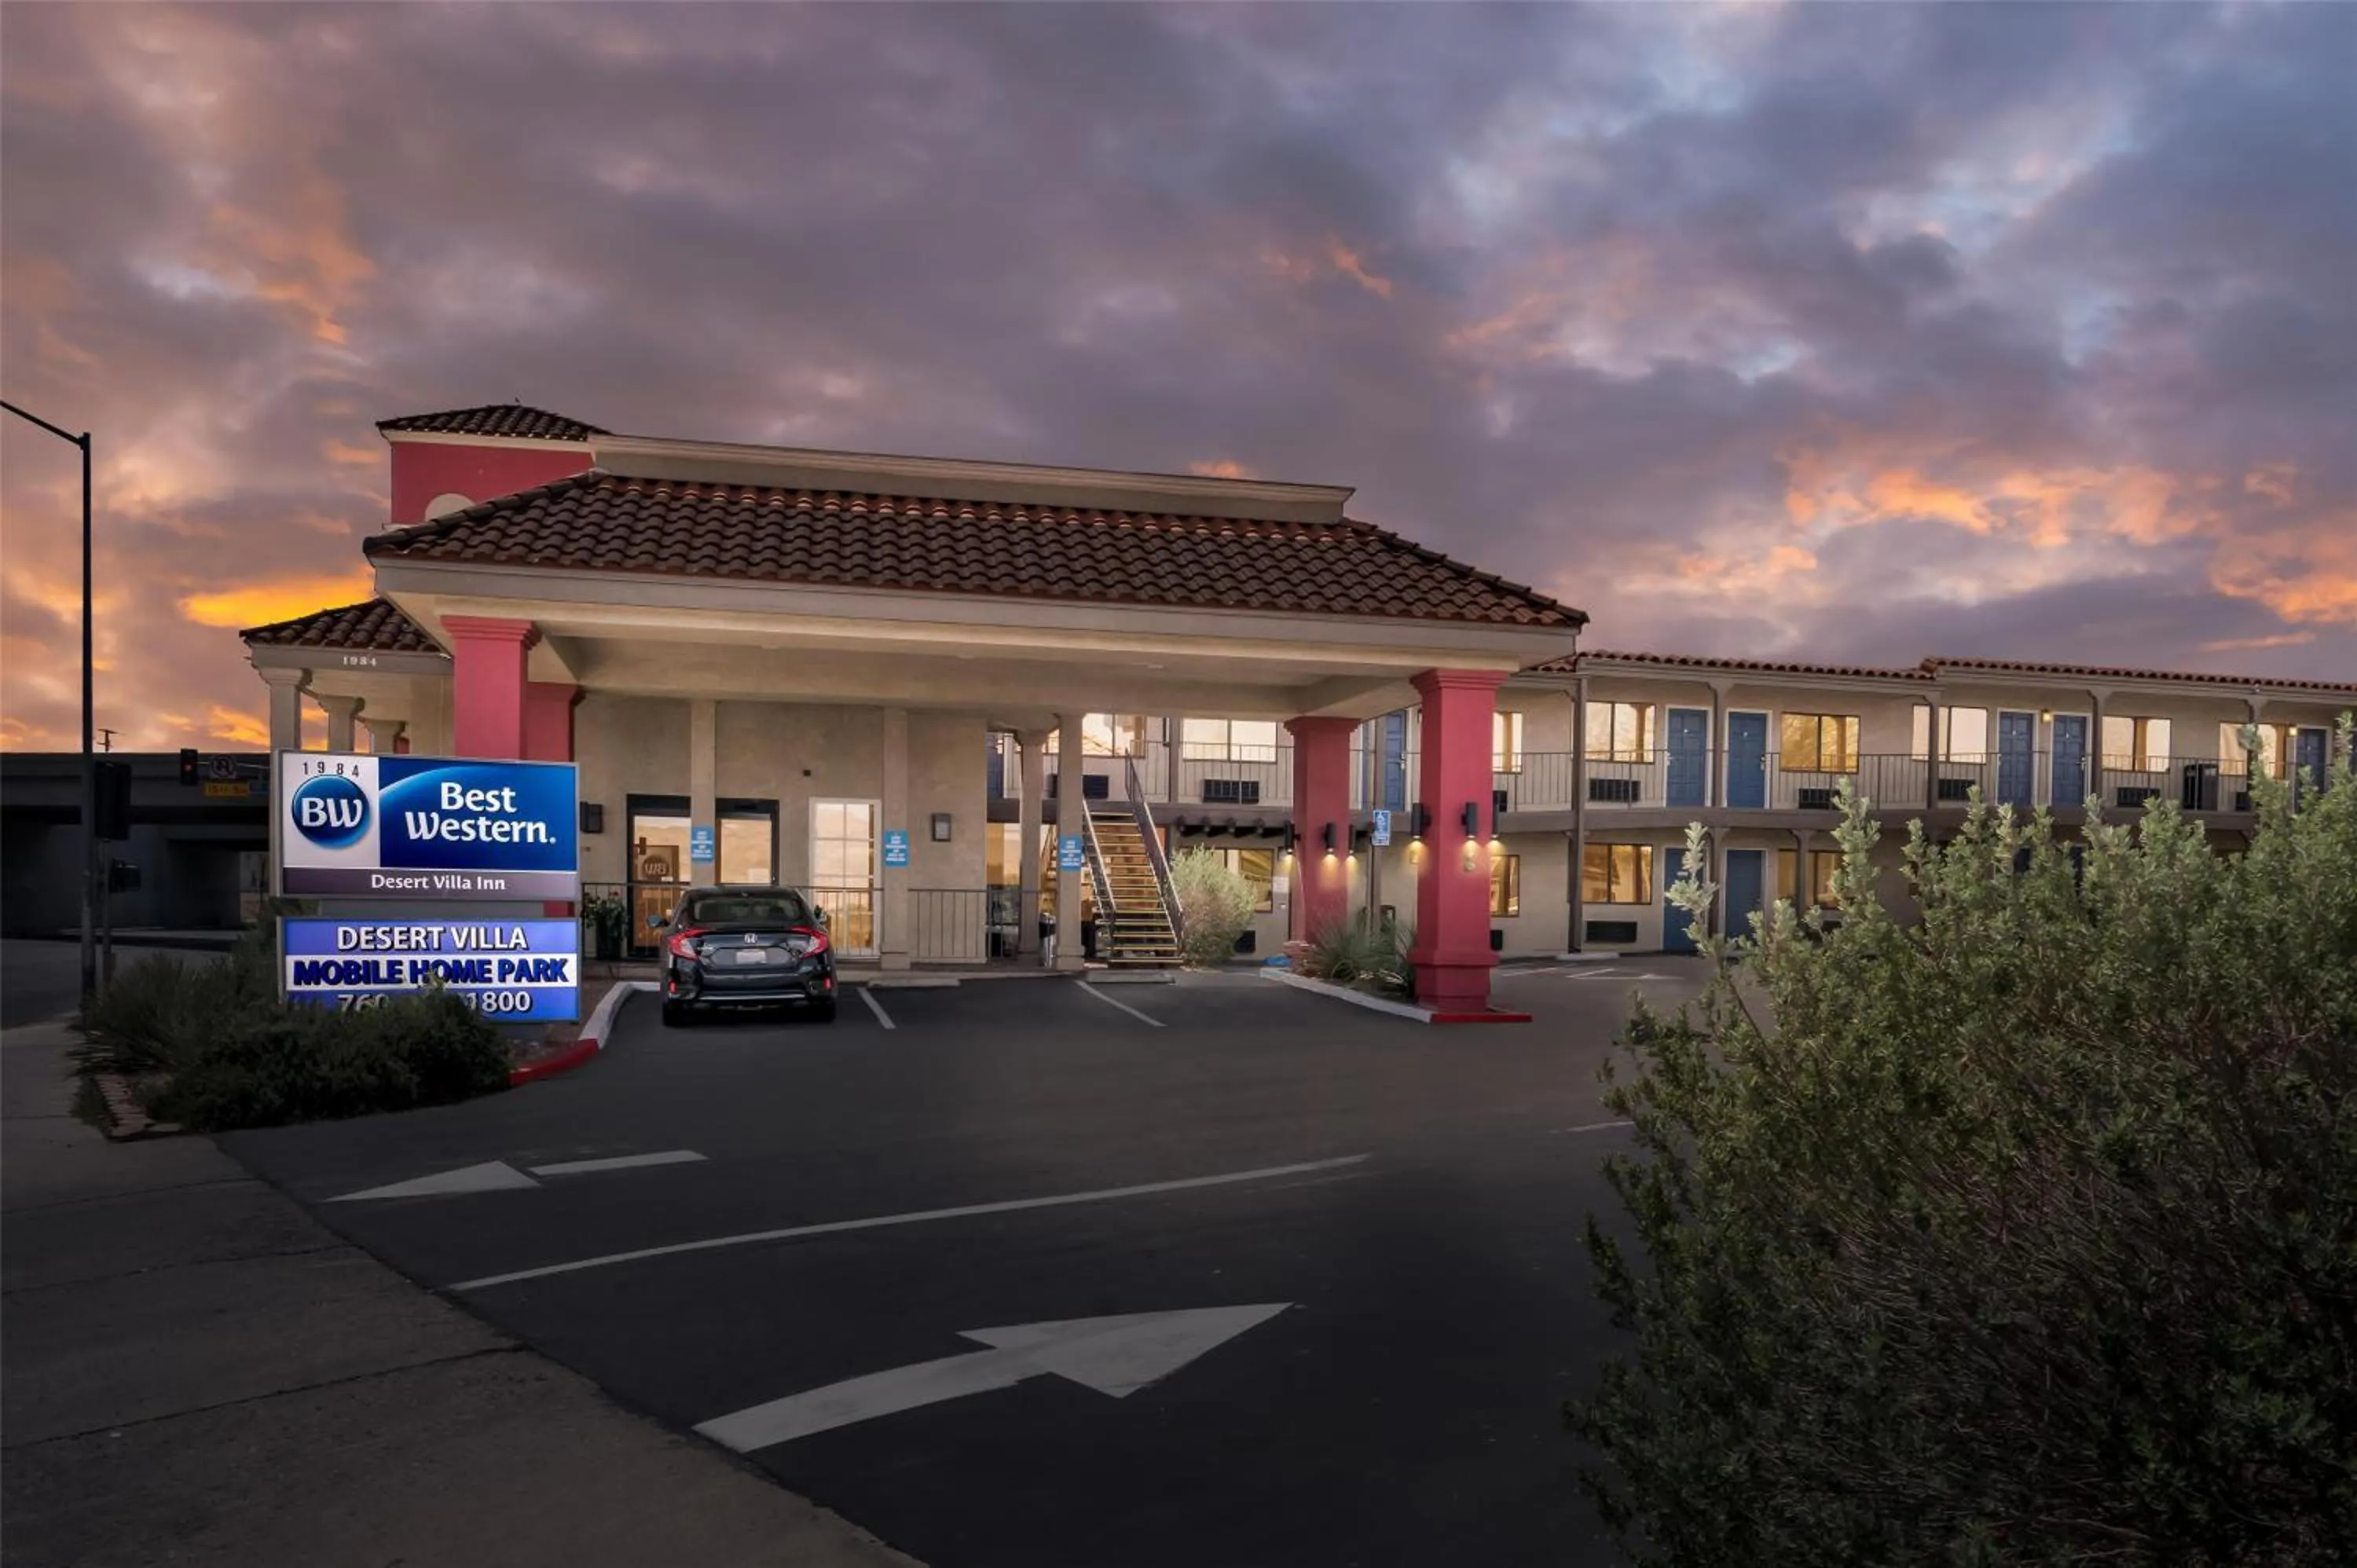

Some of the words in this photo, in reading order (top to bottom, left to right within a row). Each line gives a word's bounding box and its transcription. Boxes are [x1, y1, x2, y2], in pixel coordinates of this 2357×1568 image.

[302, 761, 360, 778] 1984
[440, 781, 519, 813] Best
[301, 797, 363, 828] BW
[371, 874, 430, 889] Desert
[433, 874, 472, 890] Villa
[476, 875, 507, 890] Inn
[337, 926, 445, 951] DESERT
[450, 925, 530, 951] VILLA
[293, 959, 404, 986] MOBILE
[409, 958, 493, 984] HOME
[497, 958, 569, 983] PARK
